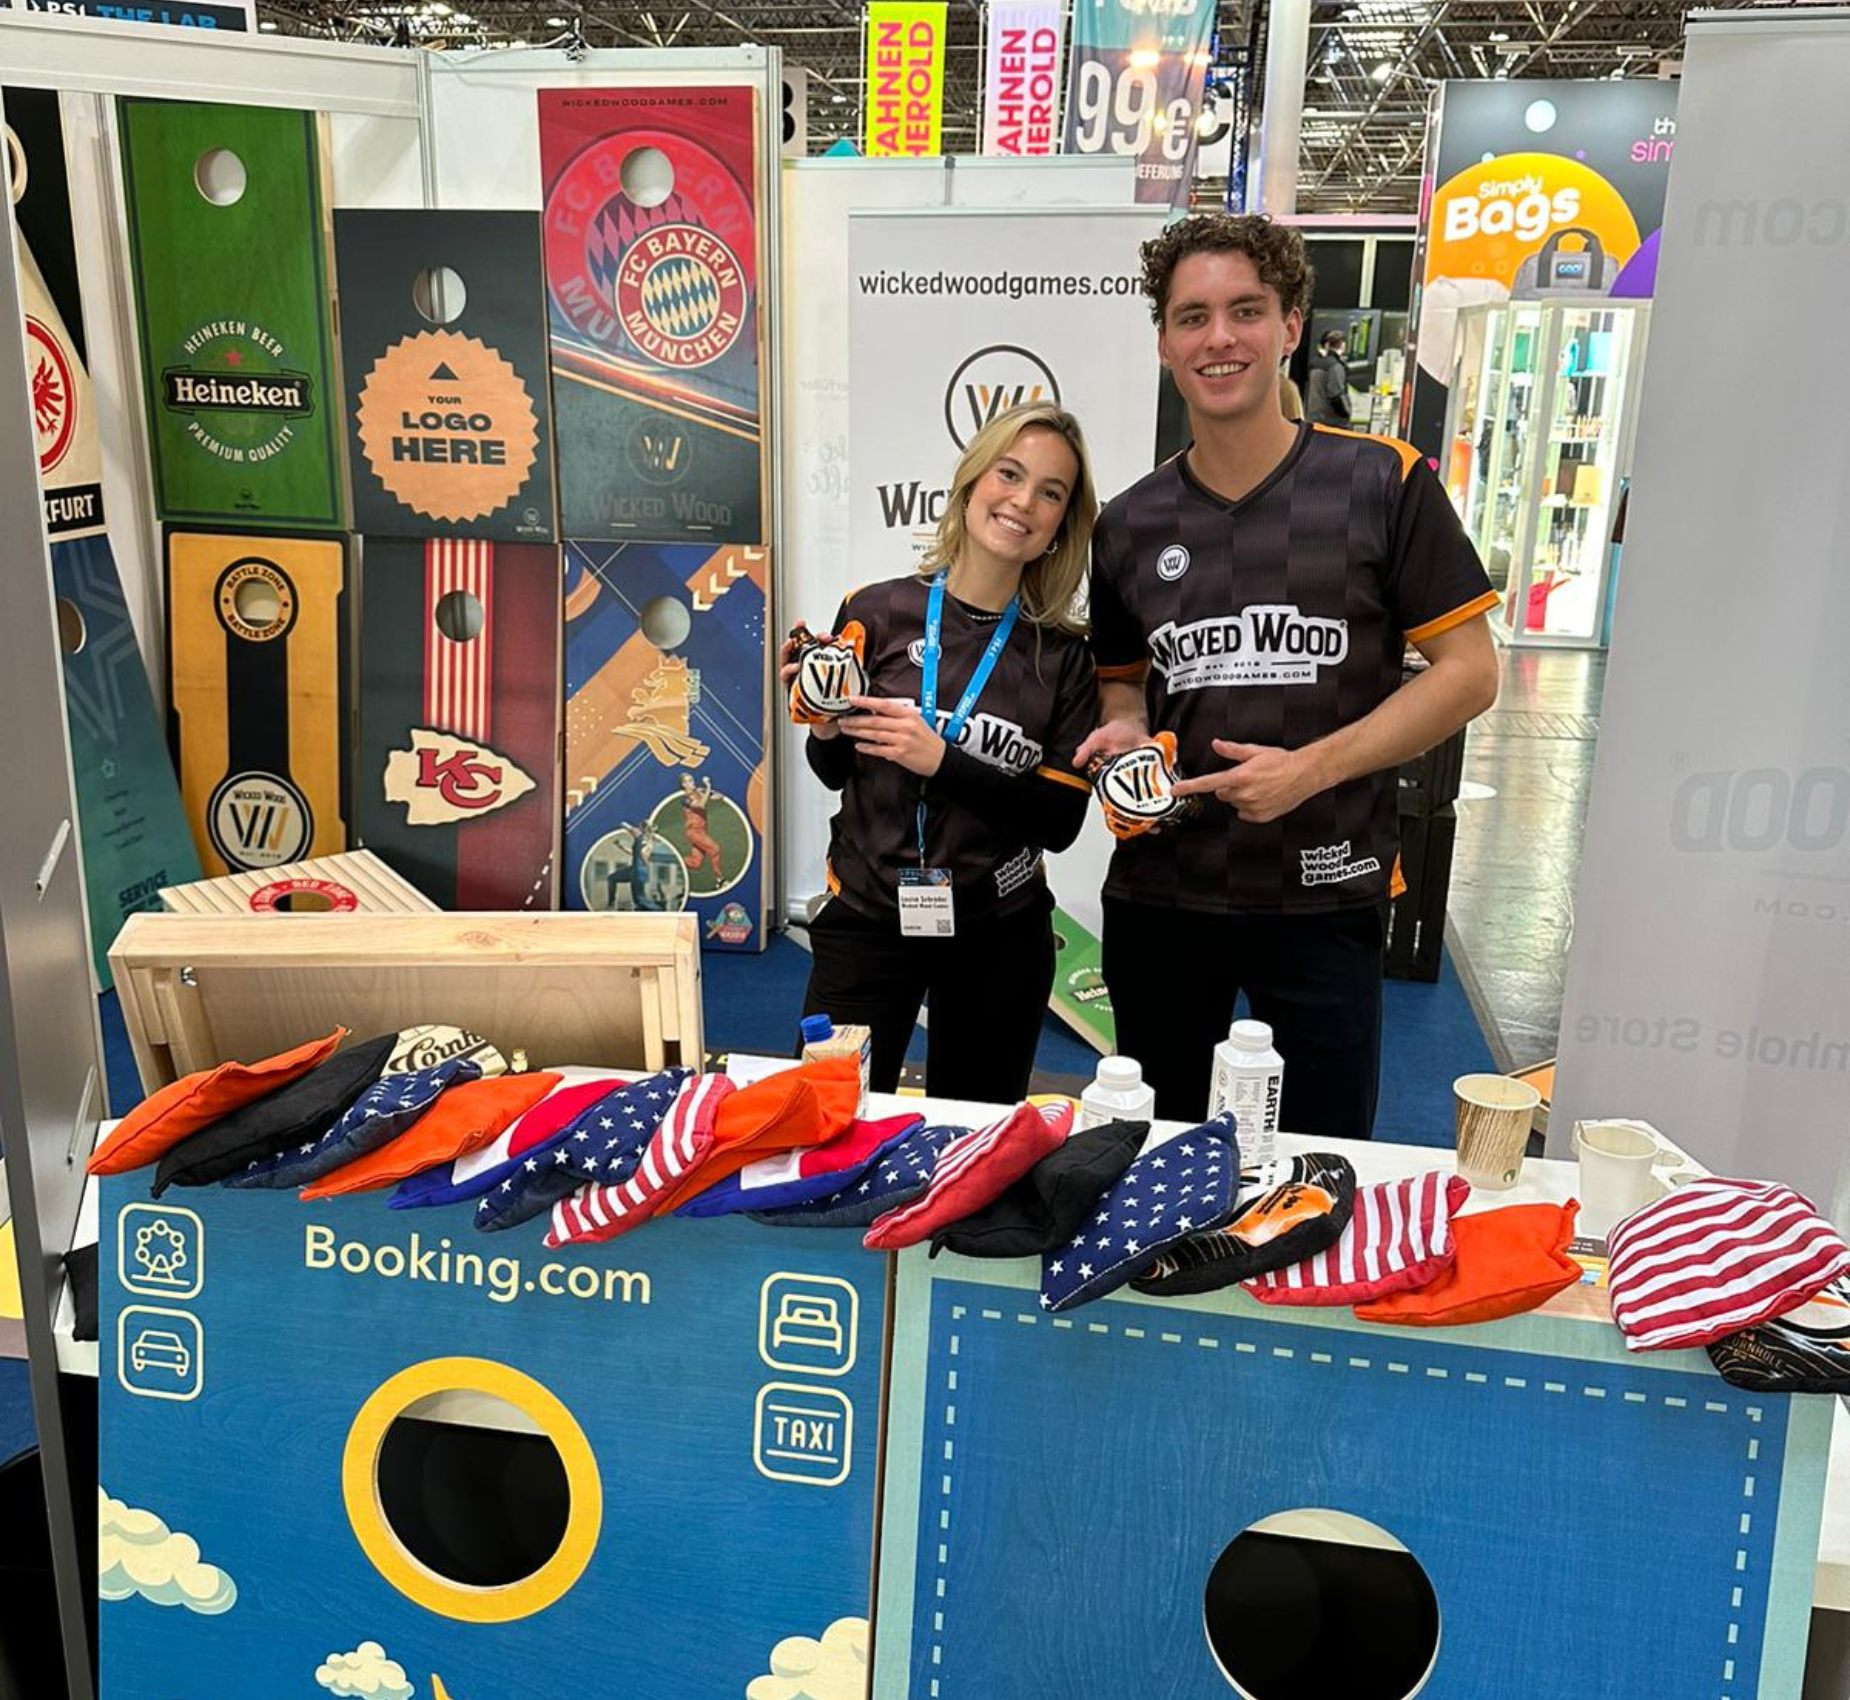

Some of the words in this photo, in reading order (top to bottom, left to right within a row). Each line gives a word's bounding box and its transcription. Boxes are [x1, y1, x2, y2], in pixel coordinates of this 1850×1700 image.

[876, 22, 903, 157] AHNEN
[997, 29, 1026, 156] AHNEN
[1479, 173, 1543, 198] Simply
[1444, 187, 1580, 242] Bags
[623, 254, 647, 288] FC
[647, 231, 738, 289] BAYERN
[184, 320, 246, 354] HEINEKEN
[251, 326, 284, 357] BEER
[626, 310, 738, 363] MÜNCHEN
[174, 377, 302, 406] Heineken
[428, 395, 463, 405] YOUR
[402, 411, 493, 432] LOGO
[188, 421, 245, 462] PREMIUM
[249, 425, 294, 463] QUALITY
[392, 437, 507, 466] HERE
[226, 566, 259, 589] BATTLE
[261, 568, 285, 591] ZONE
[227, 614, 259, 638] BATTLE
[260, 617, 286, 638] ZONE
[1250, 612, 1342, 657] WOOD
[416, 748, 503, 810] KC
[118, 869, 168, 902] SERVICE
[1263, 1075, 1280, 1132] EARTH
[305, 1224, 651, 1304] Booking.com
[774, 1416, 834, 1452] TAXI
